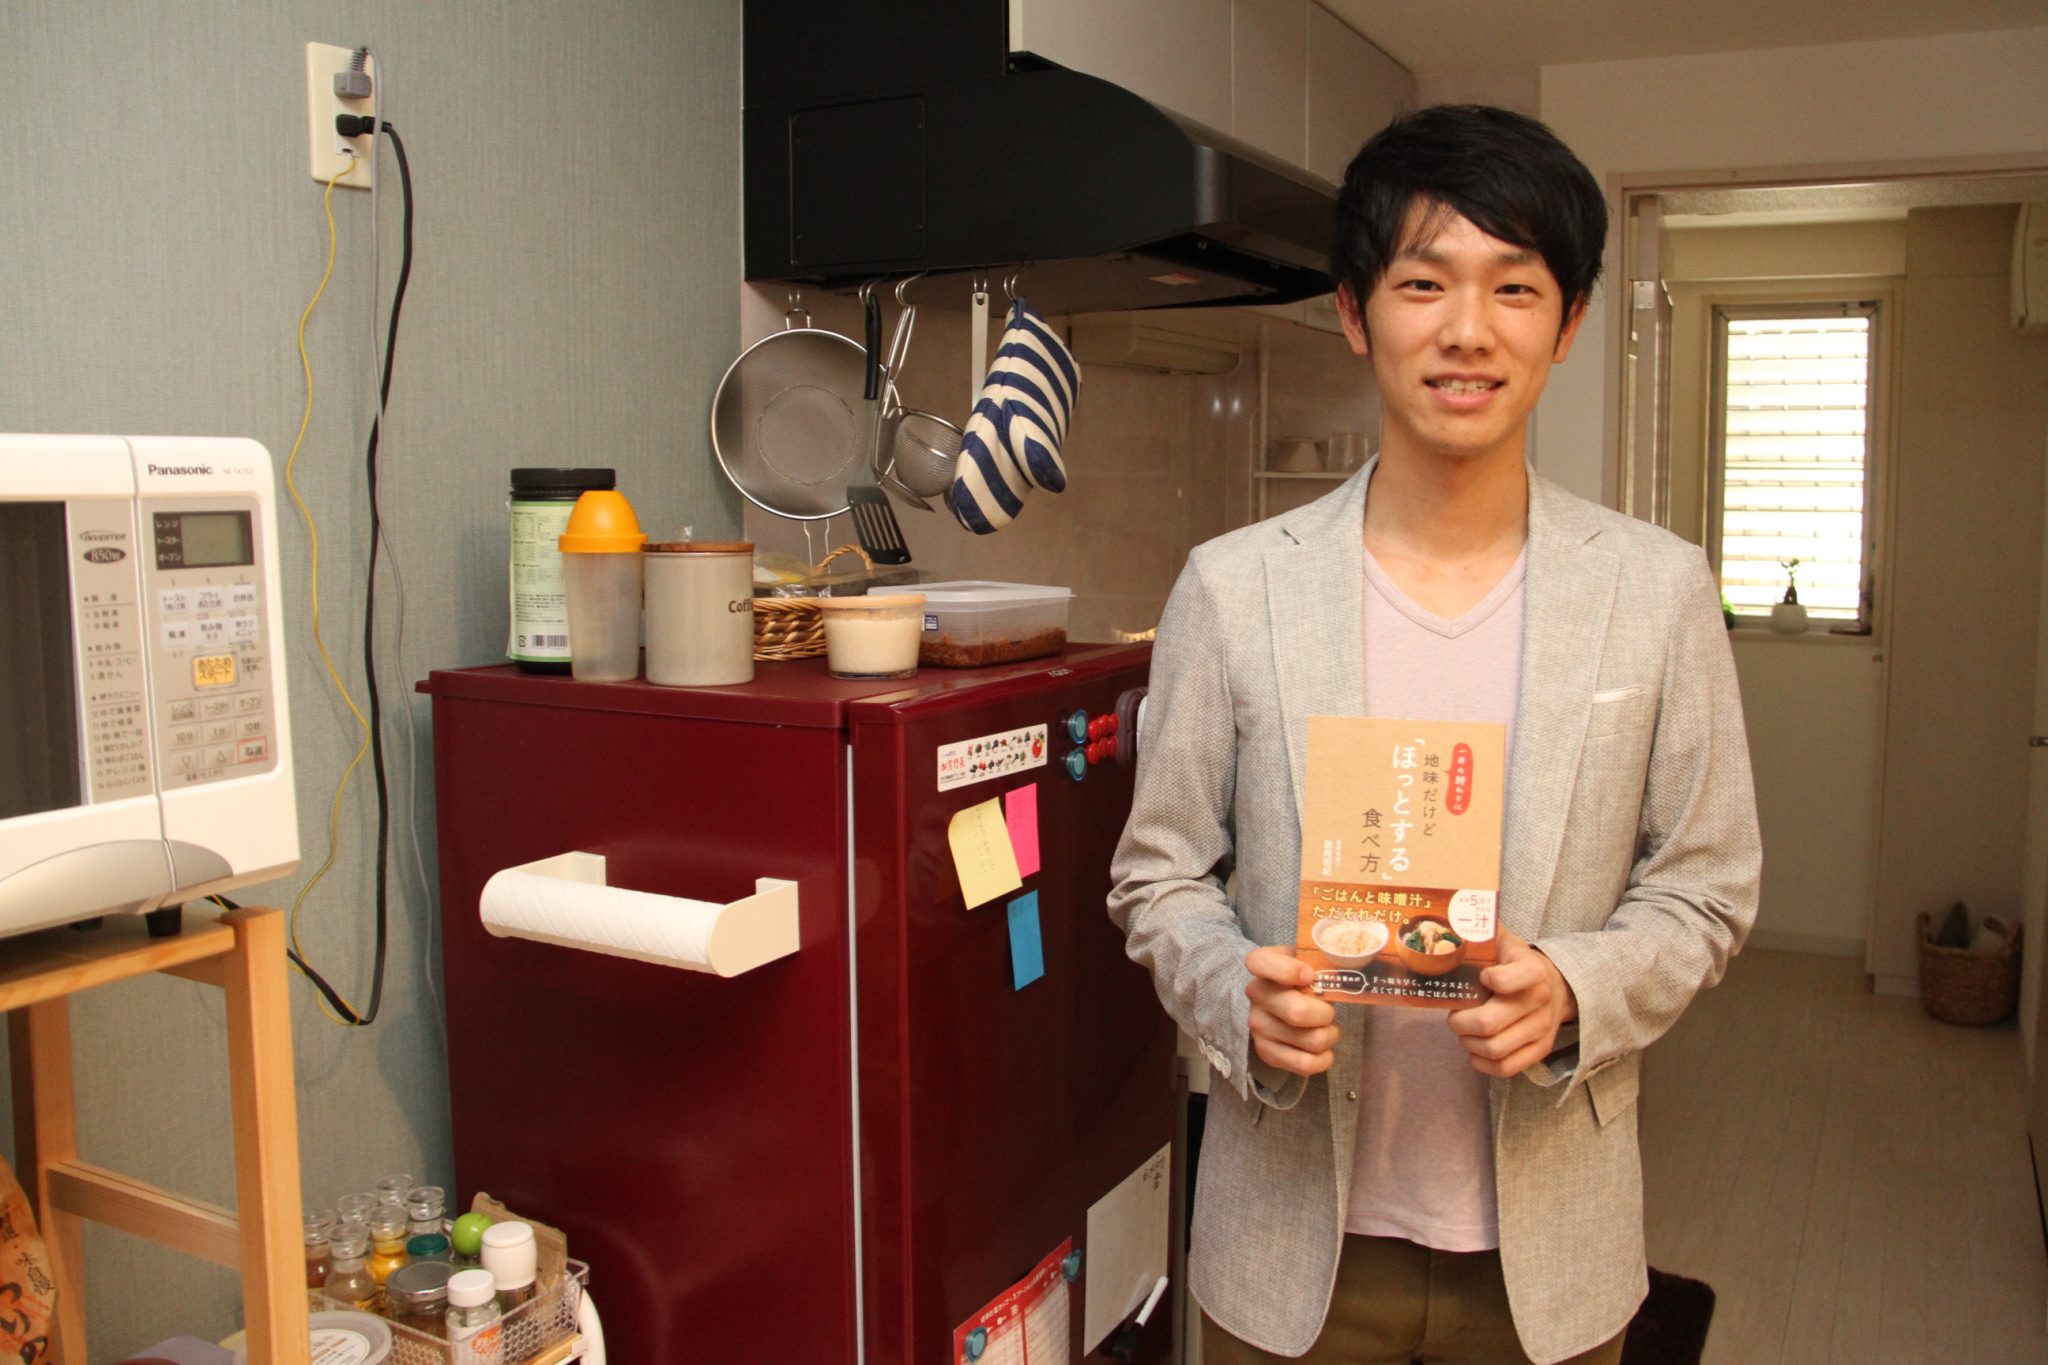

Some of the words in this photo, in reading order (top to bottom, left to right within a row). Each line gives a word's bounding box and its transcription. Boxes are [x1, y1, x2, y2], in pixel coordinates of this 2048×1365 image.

[147, 464, 213, 475] Panasonic
[84, 533, 128, 541] INVERTER
[198, 657, 232, 669] あたため
[199, 668, 231, 680] スタート
[1423, 752, 1440, 838] 地味だけど
[1381, 738, 1426, 881] 「ほっとする」
[1359, 807, 1383, 873] 食べ方
[1312, 905, 1411, 925] ただそれだけ。
[1457, 913, 1491, 928] 一汁
